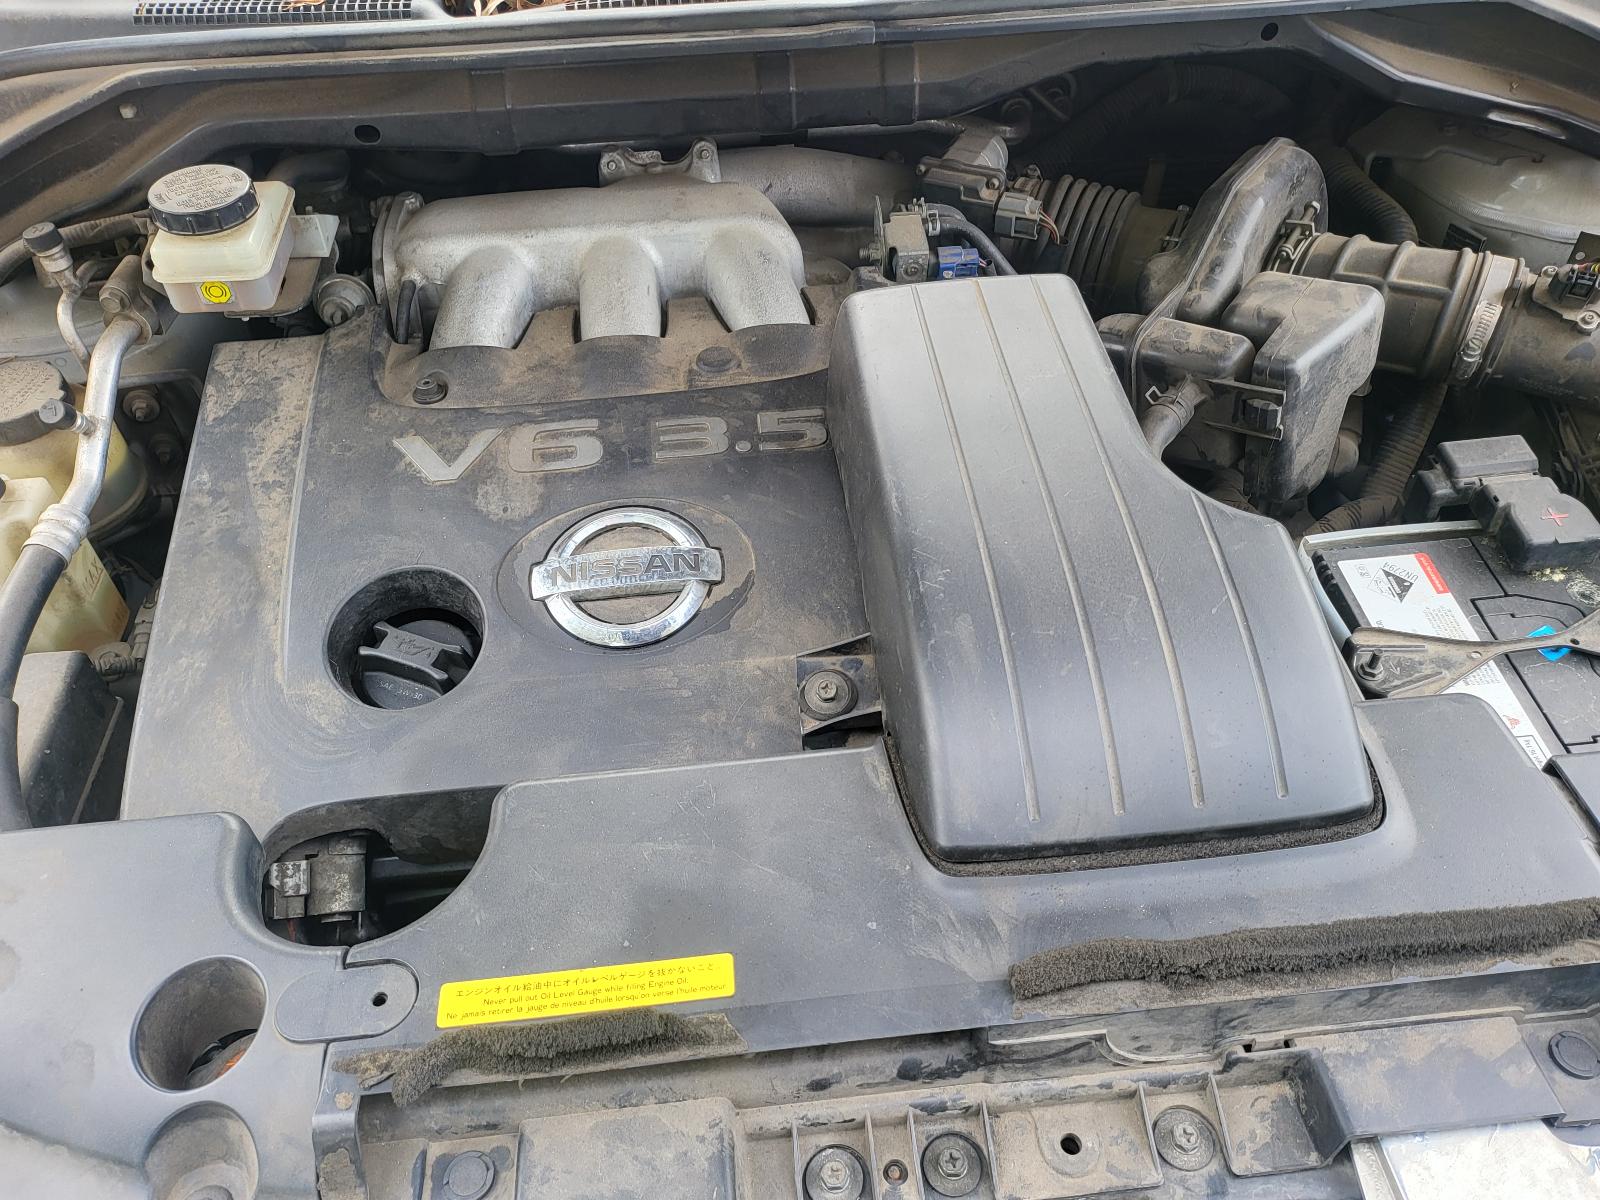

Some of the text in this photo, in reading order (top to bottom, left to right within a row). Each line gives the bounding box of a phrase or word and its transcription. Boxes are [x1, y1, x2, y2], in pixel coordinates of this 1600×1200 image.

[392, 407, 829, 483] V6 3.5
[551, 552, 700, 587] NISSAN
[446, 1012, 458, 1020] Ne
[461, 1010, 486, 1021] jamais
[488, 1006, 514, 1016] retirer
[525, 1003, 548, 1014] jauge
[550, 1001, 560, 1009] de
[561, 999, 587, 1008] niveau
[589, 996, 613, 1005] d'huile
[652, 989, 674, 998] verse
[483, 998, 507, 1006] Never
[509, 995, 523, 1005] pull
[525, 994, 538, 1002] out
[540, 992, 551, 1000] Oil
[553, 990, 576, 999] Level
[577, 987, 602, 997] Gauge
[604, 985, 624, 994] while
[648, 979, 675, 989] Engine
